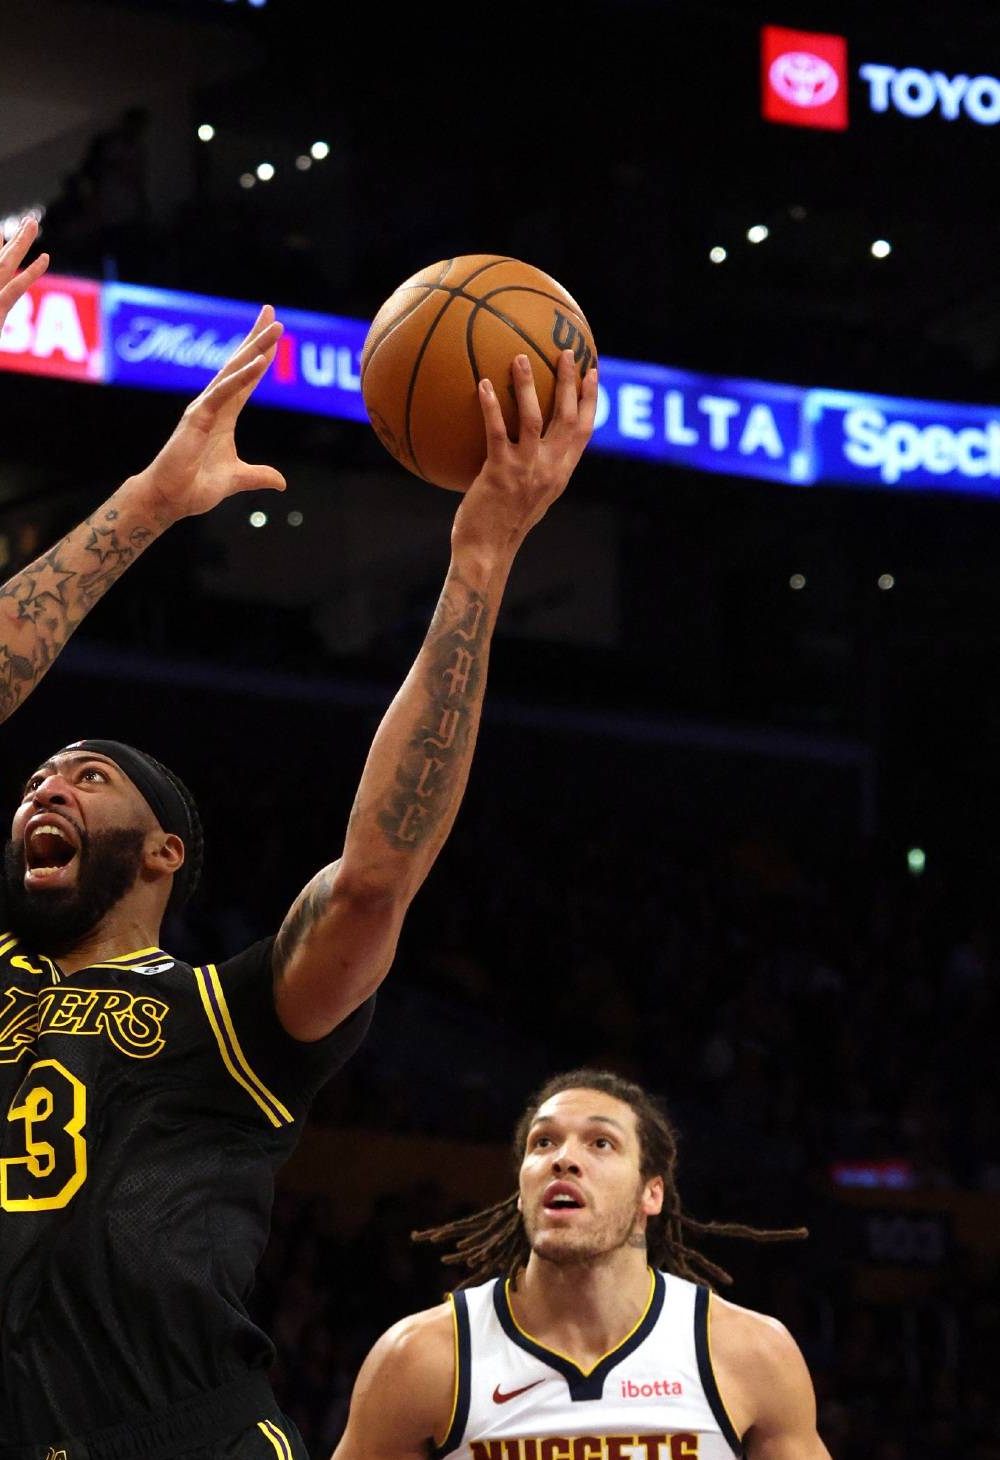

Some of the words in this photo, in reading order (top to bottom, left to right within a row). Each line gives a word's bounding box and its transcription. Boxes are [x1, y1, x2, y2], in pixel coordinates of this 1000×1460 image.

[301, 341, 364, 391] UL
[0, 1059, 87, 1212] 3
[621, 1380, 682, 1398] ibotta
